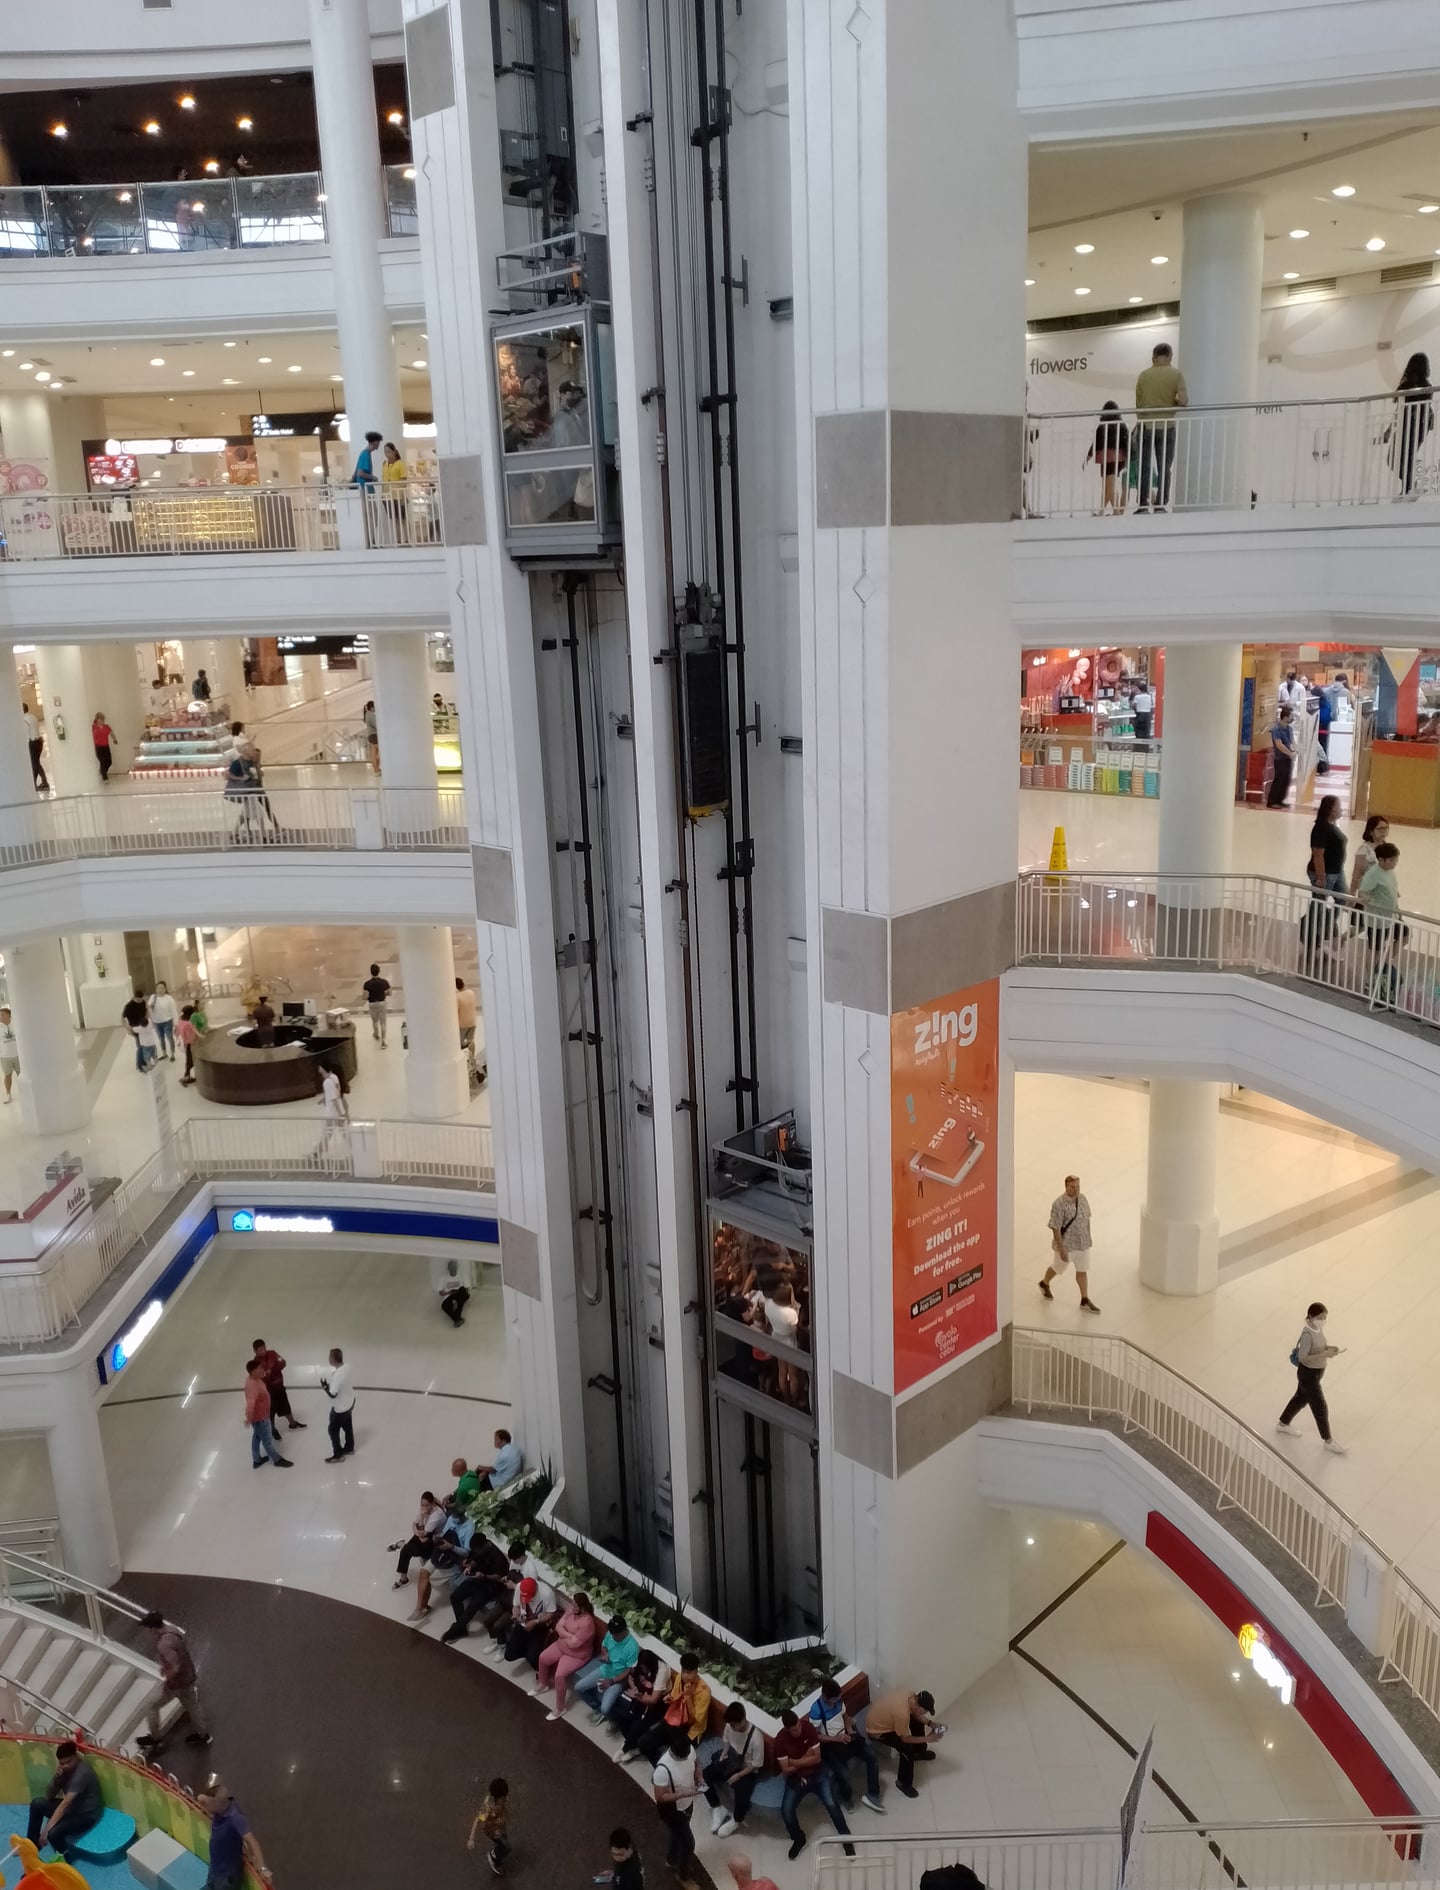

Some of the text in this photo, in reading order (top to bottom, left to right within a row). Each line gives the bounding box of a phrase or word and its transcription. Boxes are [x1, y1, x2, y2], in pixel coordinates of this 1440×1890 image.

[926, 1218, 968, 1252] ZING IT!
[914, 1233, 981, 1276] Download the app
[933, 1264, 945, 1278] for
